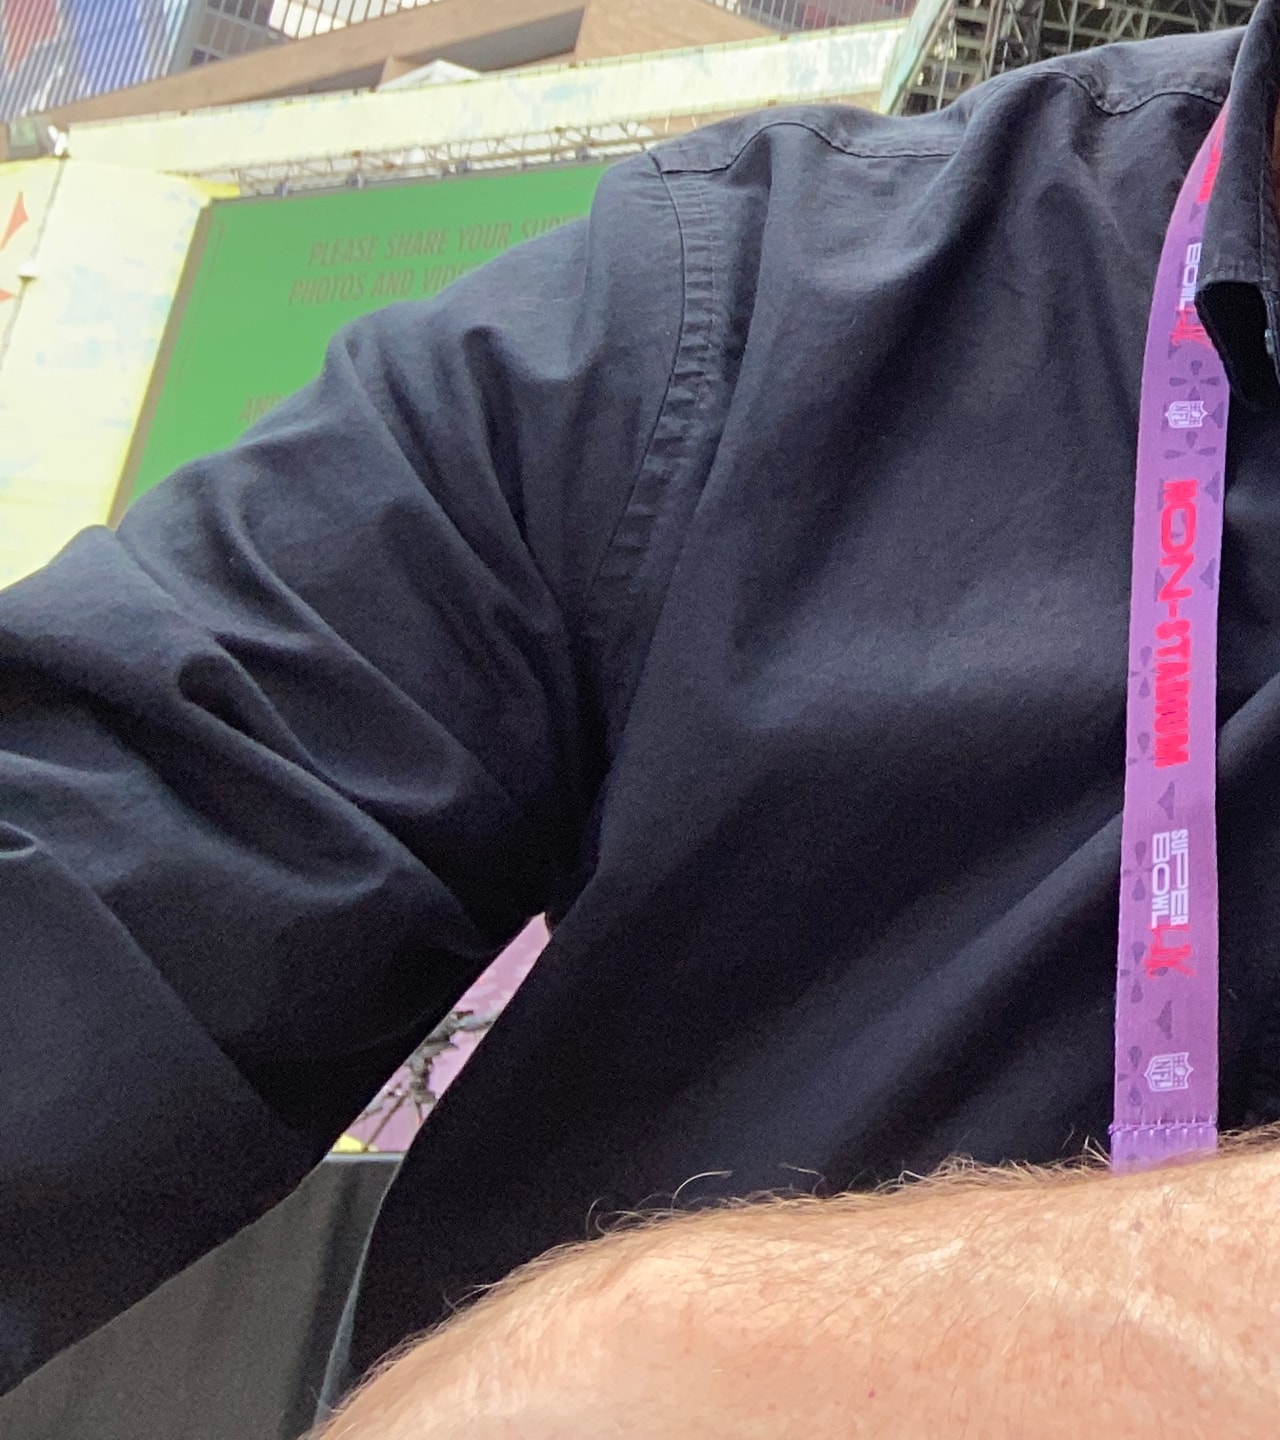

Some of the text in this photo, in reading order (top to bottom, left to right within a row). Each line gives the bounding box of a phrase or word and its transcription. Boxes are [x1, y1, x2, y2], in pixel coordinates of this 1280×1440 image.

[308, 237, 378, 267] PLEASE
[385, 228, 450, 259] SHARE
[458, 222, 513, 251] YOUR
[289, 273, 368, 307] PHOTOS
[371, 269, 415, 298] AND
[1151, 831, 1171, 930] BOWL
[1169, 828, 1189, 927] SUPER
